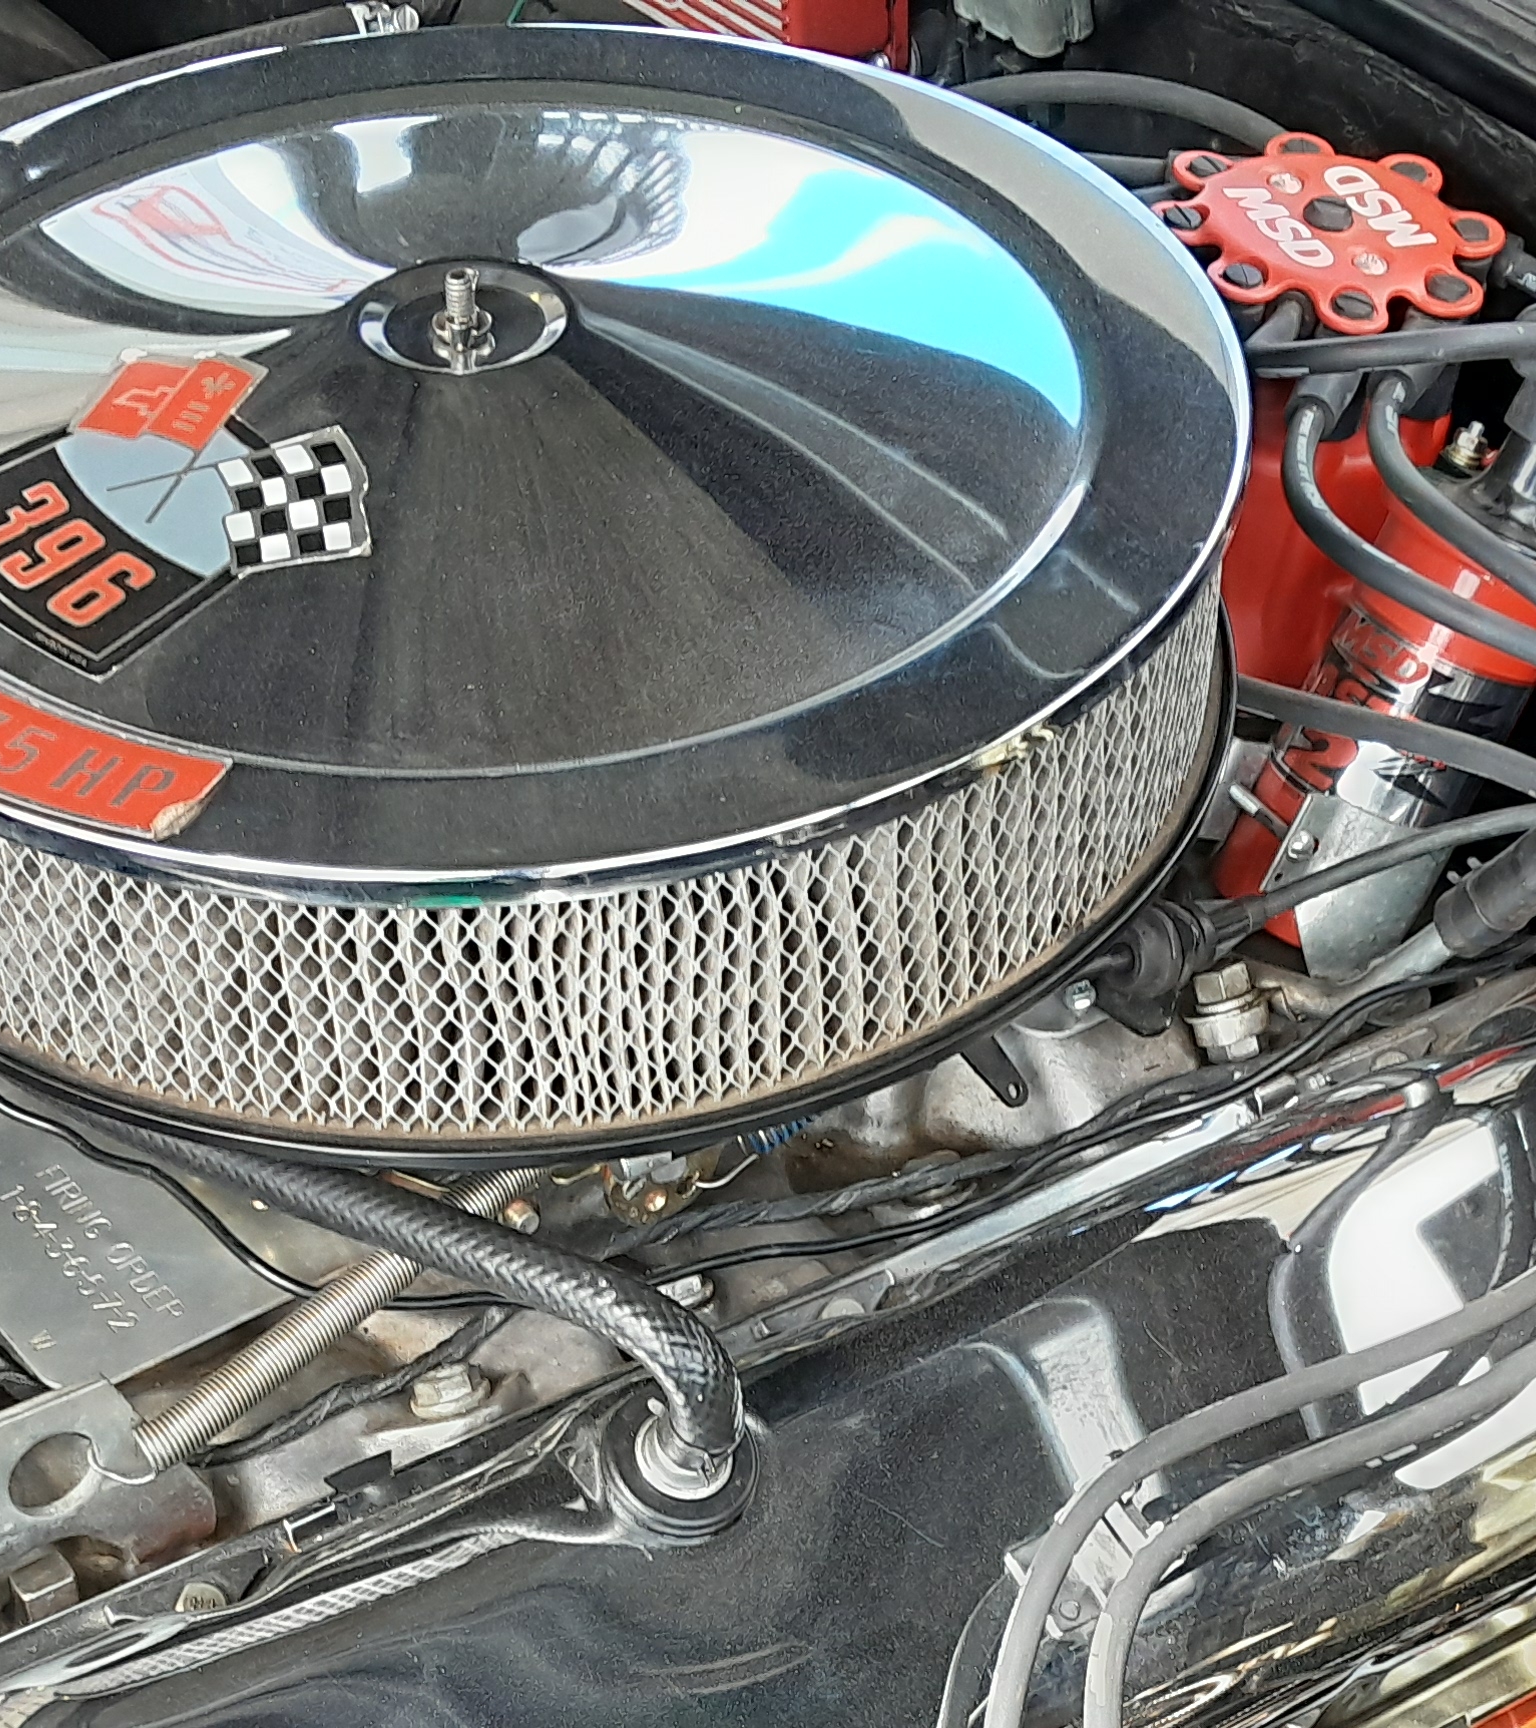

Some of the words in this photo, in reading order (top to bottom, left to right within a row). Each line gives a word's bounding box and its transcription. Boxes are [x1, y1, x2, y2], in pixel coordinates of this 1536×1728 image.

[1225, 185, 1336, 270] MSD
[1323, 166, 1435, 247] MSD
[54, 742, 176, 807] HP
[34, 1165, 112, 1240] FIRING
